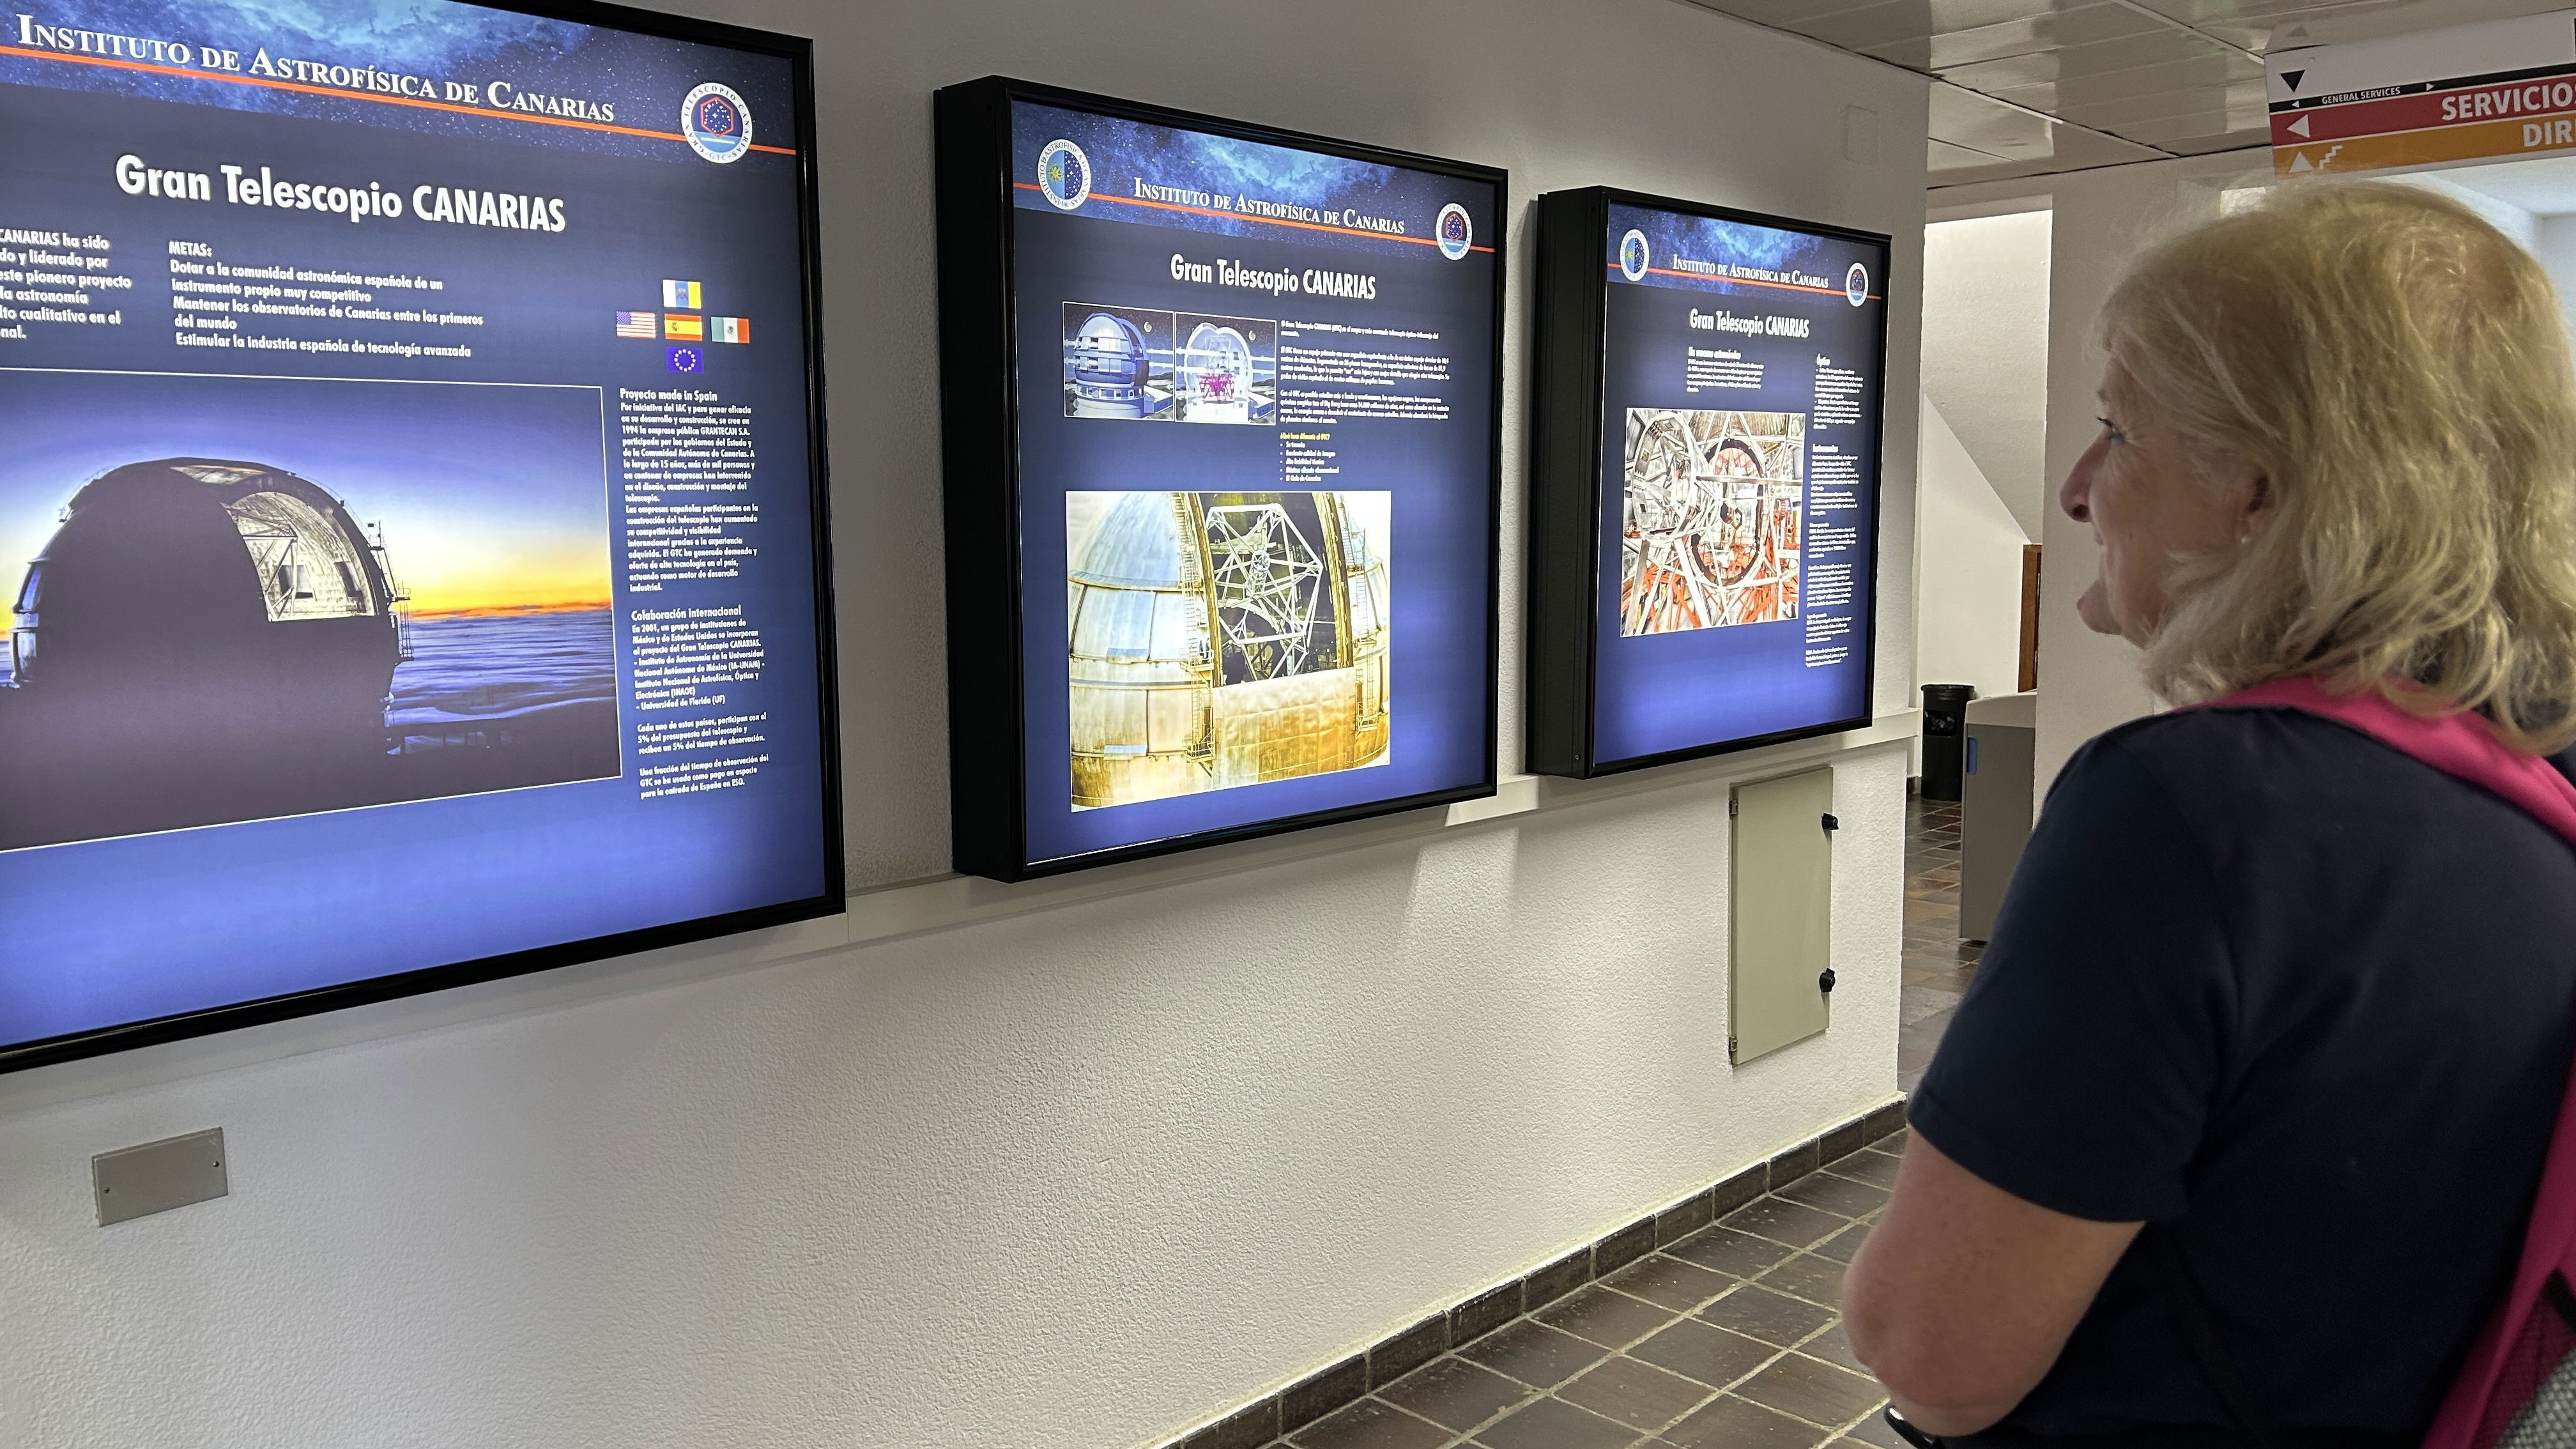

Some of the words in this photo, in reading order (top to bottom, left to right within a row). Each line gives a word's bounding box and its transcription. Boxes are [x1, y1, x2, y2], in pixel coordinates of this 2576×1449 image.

[16, 14, 190, 63] INSTITUTO
[200, 47, 240, 71] DE
[249, 48, 437, 98] ASTROFÍSICA
[445, 82, 479, 103] DE
[488, 82, 614, 121] CANARIAS
[2322, 93, 2359, 104] GENERAL
[2361, 87, 2400, 99] SERVICES
[2442, 81, 2576, 121] SERVICIO
[684, 86, 736, 116] TELESCOPIO
[732, 104, 749, 157] CANARIAS
[2523, 118, 2576, 147] DIR
[116, 155, 210, 201] Gran
[221, 165, 402, 222] Telescopio
[413, 186, 565, 232] CANARIAS
[1134, 177, 1209, 206] INSTITUTO
[1214, 195, 1231, 210] DE
[1234, 194, 1320, 222] ASTROFÍSICA
[1324, 211, 1340, 225] DE
[1344, 209, 1404, 234] CANARIAS
[62, 232, 80, 248] ha
[82, 234, 110, 250] sido
[169, 241, 212, 257] METAS:
[17, 252, 26, 266] y
[29, 249, 84, 267] liderado
[86, 257, 109, 271] por
[1673, 254, 1714, 273] INSTITUTO
[1717, 264, 1728, 275] DE
[1729, 263, 1778, 282] ASTROFÍSICA
[1781, 272, 1790, 283] DE
[1792, 270, 1828, 288] CANARIAS
[26, 269, 76, 286] pionero
[78, 275, 132, 289] proyecto
[170, 259, 204, 274] Dotar
[206, 265, 215, 275] a
[217, 261, 229, 276] la
[231, 266, 294, 280] comunidad
[296, 270, 362, 285] astronómica
[364, 275, 412, 289] española
[414, 275, 427, 289] de
[429, 280, 443, 290] un
[1171, 254, 1211, 283] Gran
[1217, 259, 1298, 296] Telescopio
[1303, 270, 1376, 299] CANARIAS
[0, 285, 13, 300] la
[15, 289, 89, 304] astronomía
[171, 278, 241, 295] instrumento
[243, 284, 281, 299] propio
[283, 288, 307, 301] muy
[309, 289, 372, 303] competitivo
[19, 306, 87, 323] cualitativo
[89, 313, 105, 324] en
[107, 310, 121, 325] el
[173, 295, 230, 312] Mantener
[232, 298, 249, 312] los
[251, 300, 326, 317] observatorios
[328, 304, 343, 318] de
[344, 305, 392, 320] Canarias
[393, 310, 420, 322] entre
[422, 309, 438, 323] los
[440, 312, 484, 326] primeros
[174, 313, 194, 328] del
[196, 316, 237, 330] mundo
[1690, 309, 1713, 330] Gran
[1716, 310, 1763, 337] Telescopio
[1766, 316, 1809, 337] CANARIAS
[176, 332, 231, 347] Estimular
[233, 334, 245, 348] la
[247, 335, 297, 349] industria
[299, 339, 349, 353] española
[351, 339, 365, 353] de
[367, 341, 421, 357] tecnología
[423, 344, 471, 357] avanzada
[620, 387, 657, 401] Proyecto
[658, 388, 682, 400] made
[684, 390, 693, 401] in
[693, 390, 717, 403] Spain
[631, 608, 686, 621] Colaboración
[688, 605, 741, 618] internacional
